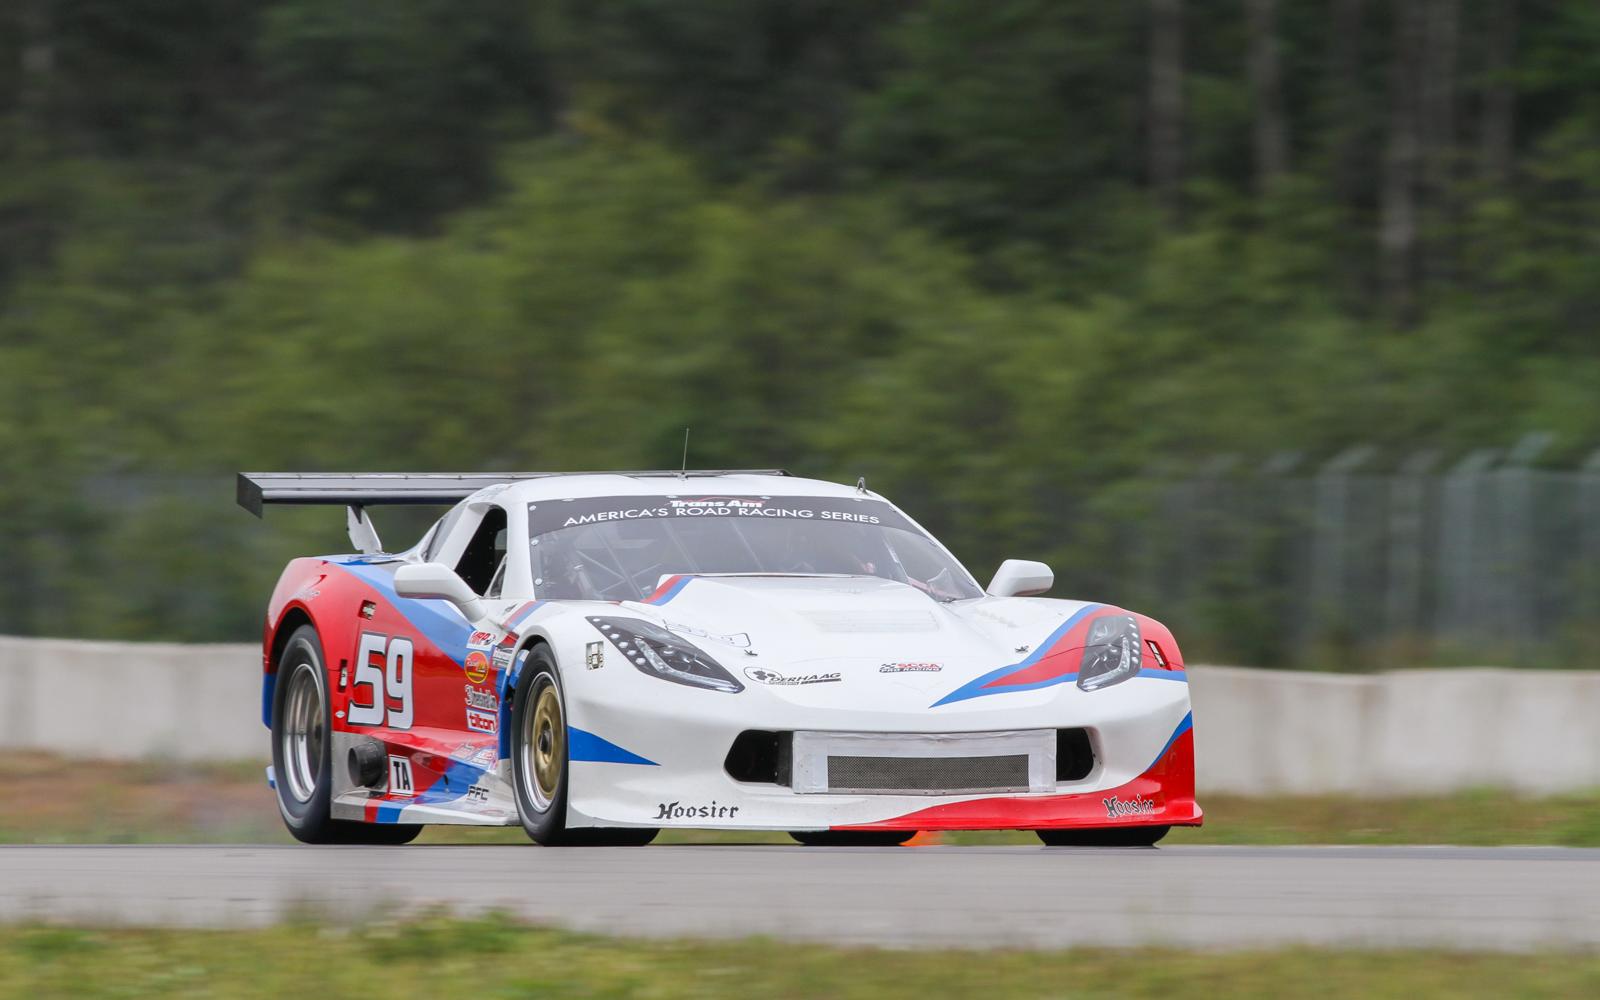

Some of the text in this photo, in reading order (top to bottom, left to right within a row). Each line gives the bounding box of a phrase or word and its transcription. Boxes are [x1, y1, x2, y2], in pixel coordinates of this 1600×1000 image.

[670, 500, 762, 508] Trans Am
[564, 508, 880, 527] AMERICA'S ROAD RACING SERIES
[347, 632, 414, 729] 59
[393, 761, 411, 790] TA
[652, 800, 739, 819] Hoosier
